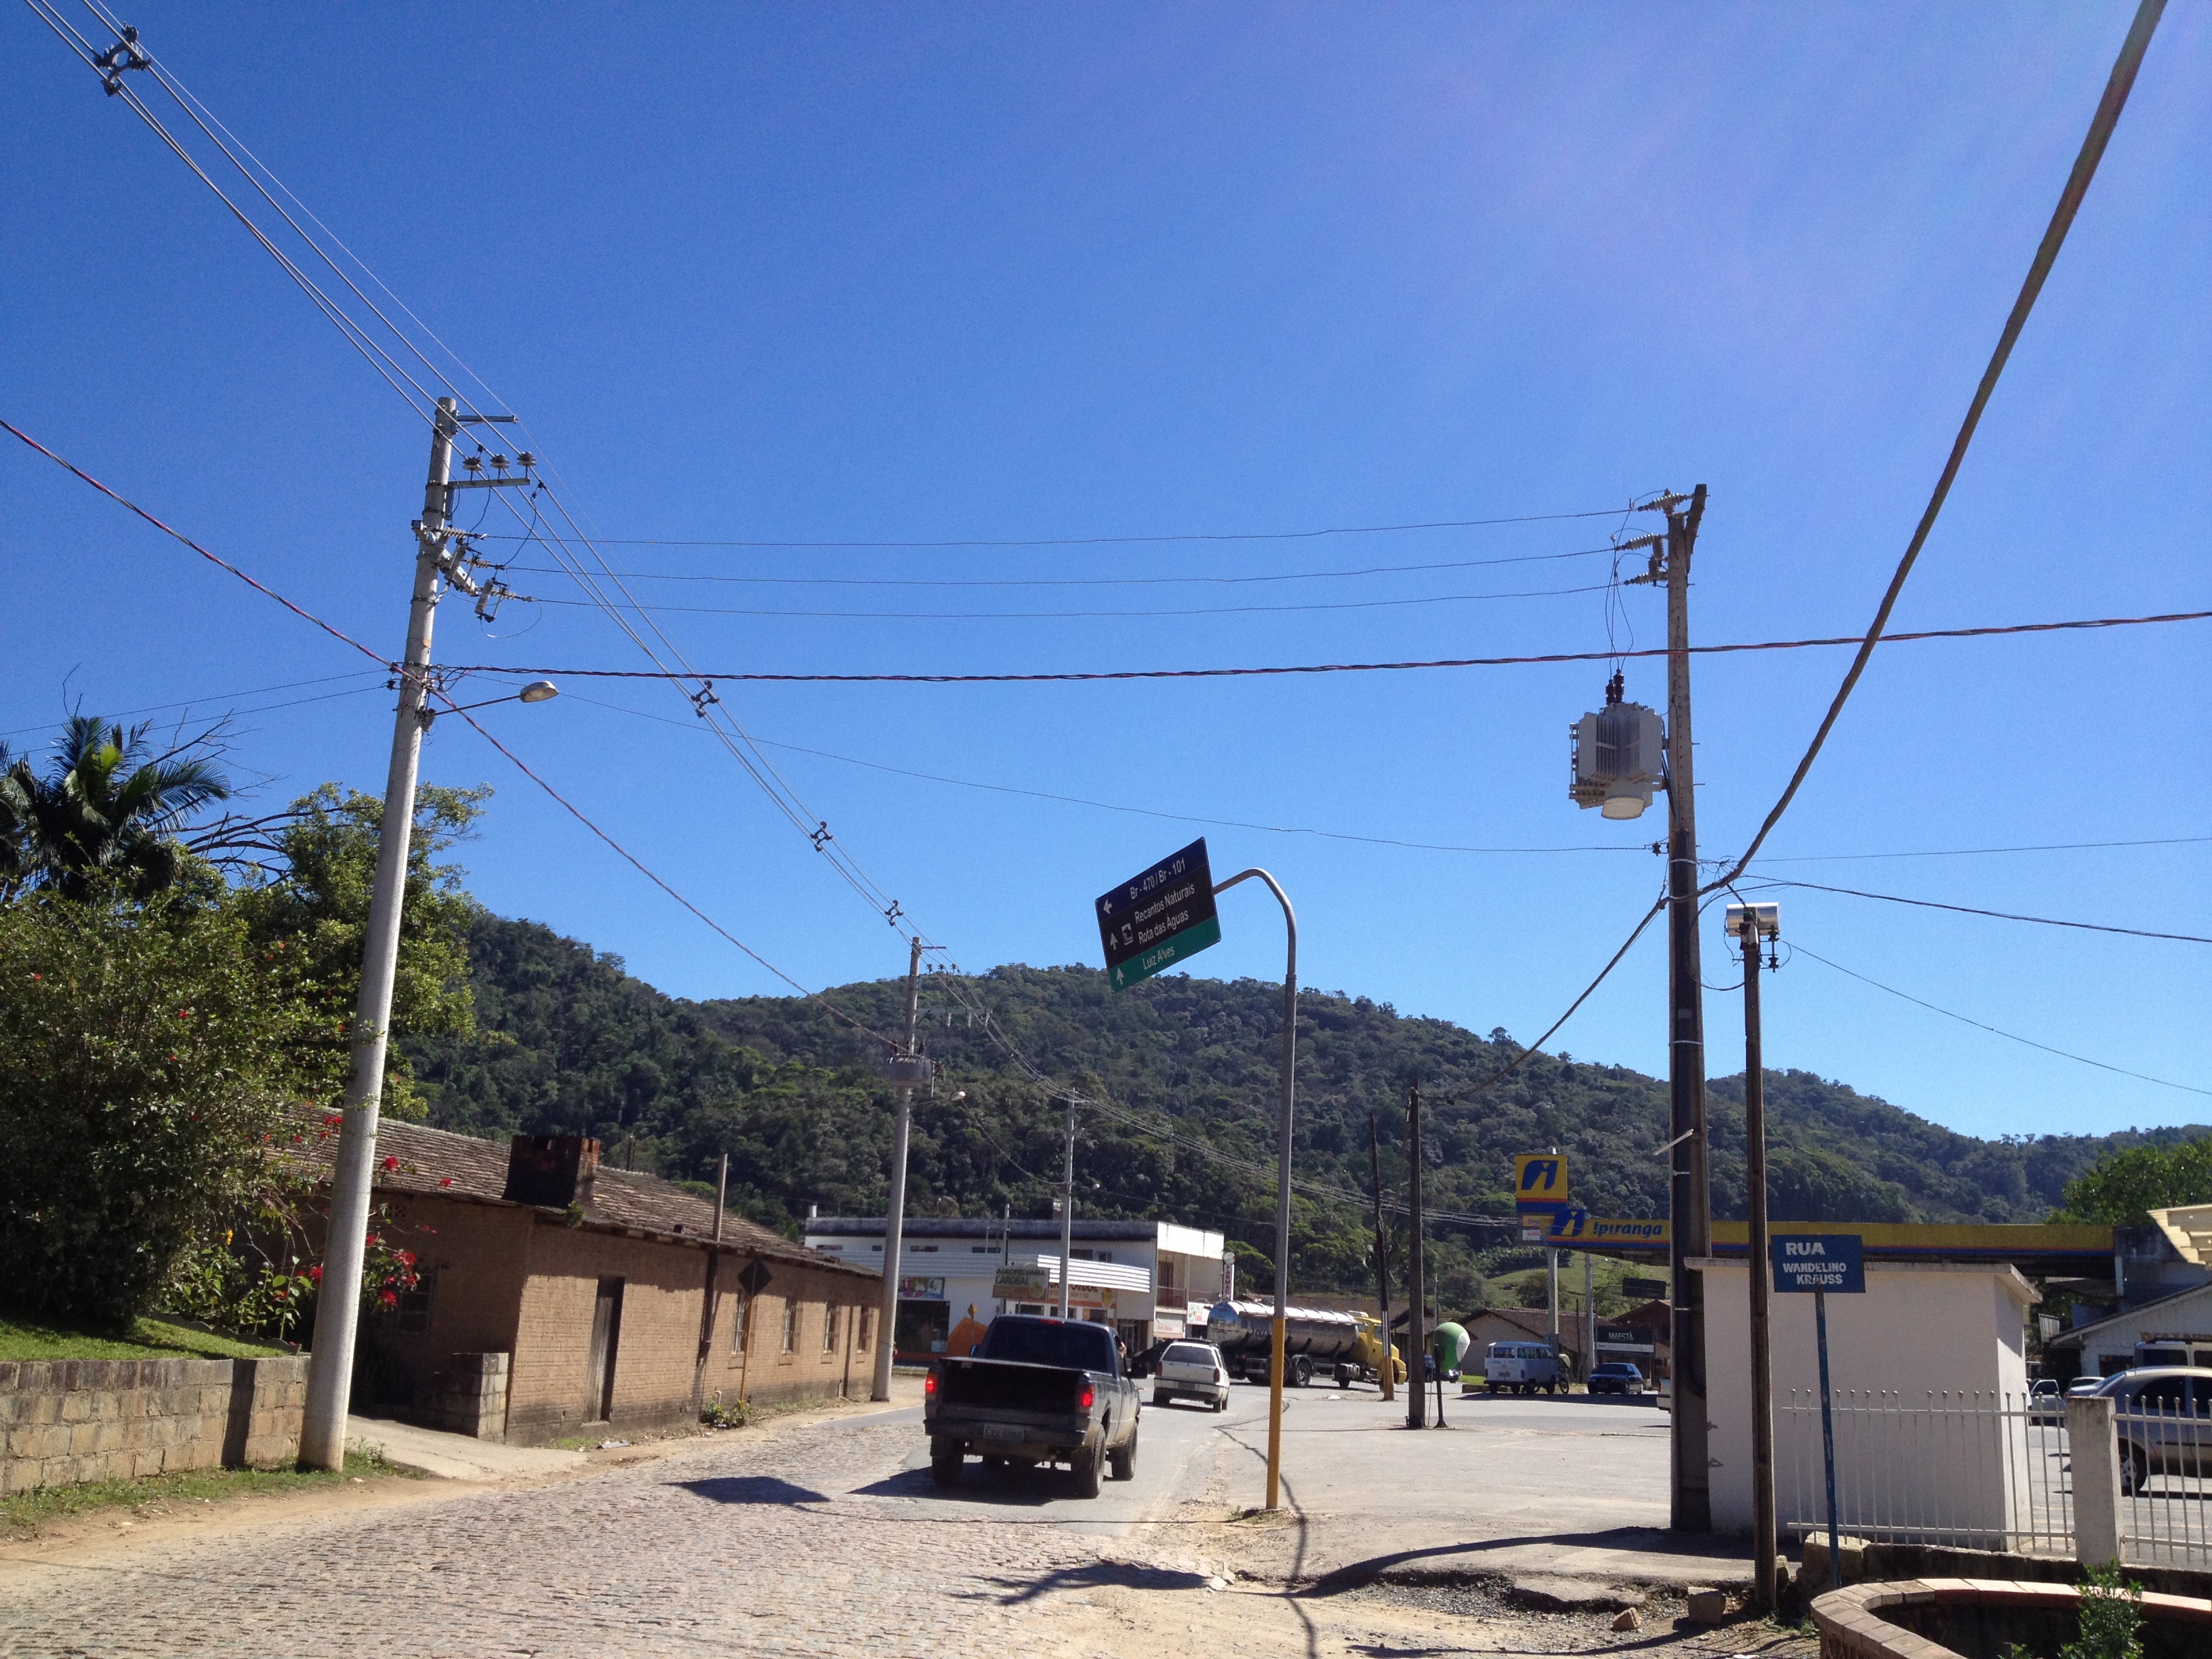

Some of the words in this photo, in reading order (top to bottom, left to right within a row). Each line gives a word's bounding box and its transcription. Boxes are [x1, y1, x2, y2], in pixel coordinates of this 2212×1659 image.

[1130, 886, 1139, 900] Br
[1143, 875, 1155, 893] 470
[1159, 870, 1167, 884] Br
[1172, 857, 1186, 875] 101
[1134, 899, 1165, 924] Recantos
[1164, 883, 1195, 908] Naturais
[1138, 928, 1153, 945] Rota
[1154, 922, 1166, 937] das
[1166, 909, 1189, 931] Águas
[1142, 954, 1158, 970] Luiz
[1158, 945, 1175, 964] Alves
[1785, 1242, 1826, 1255] RUA
[1782, 1263, 1847, 1273] WANDELINO
[995, 1275, 1030, 1286] CARDEAL
[1796, 1274, 1843, 1284] KRAUSS
